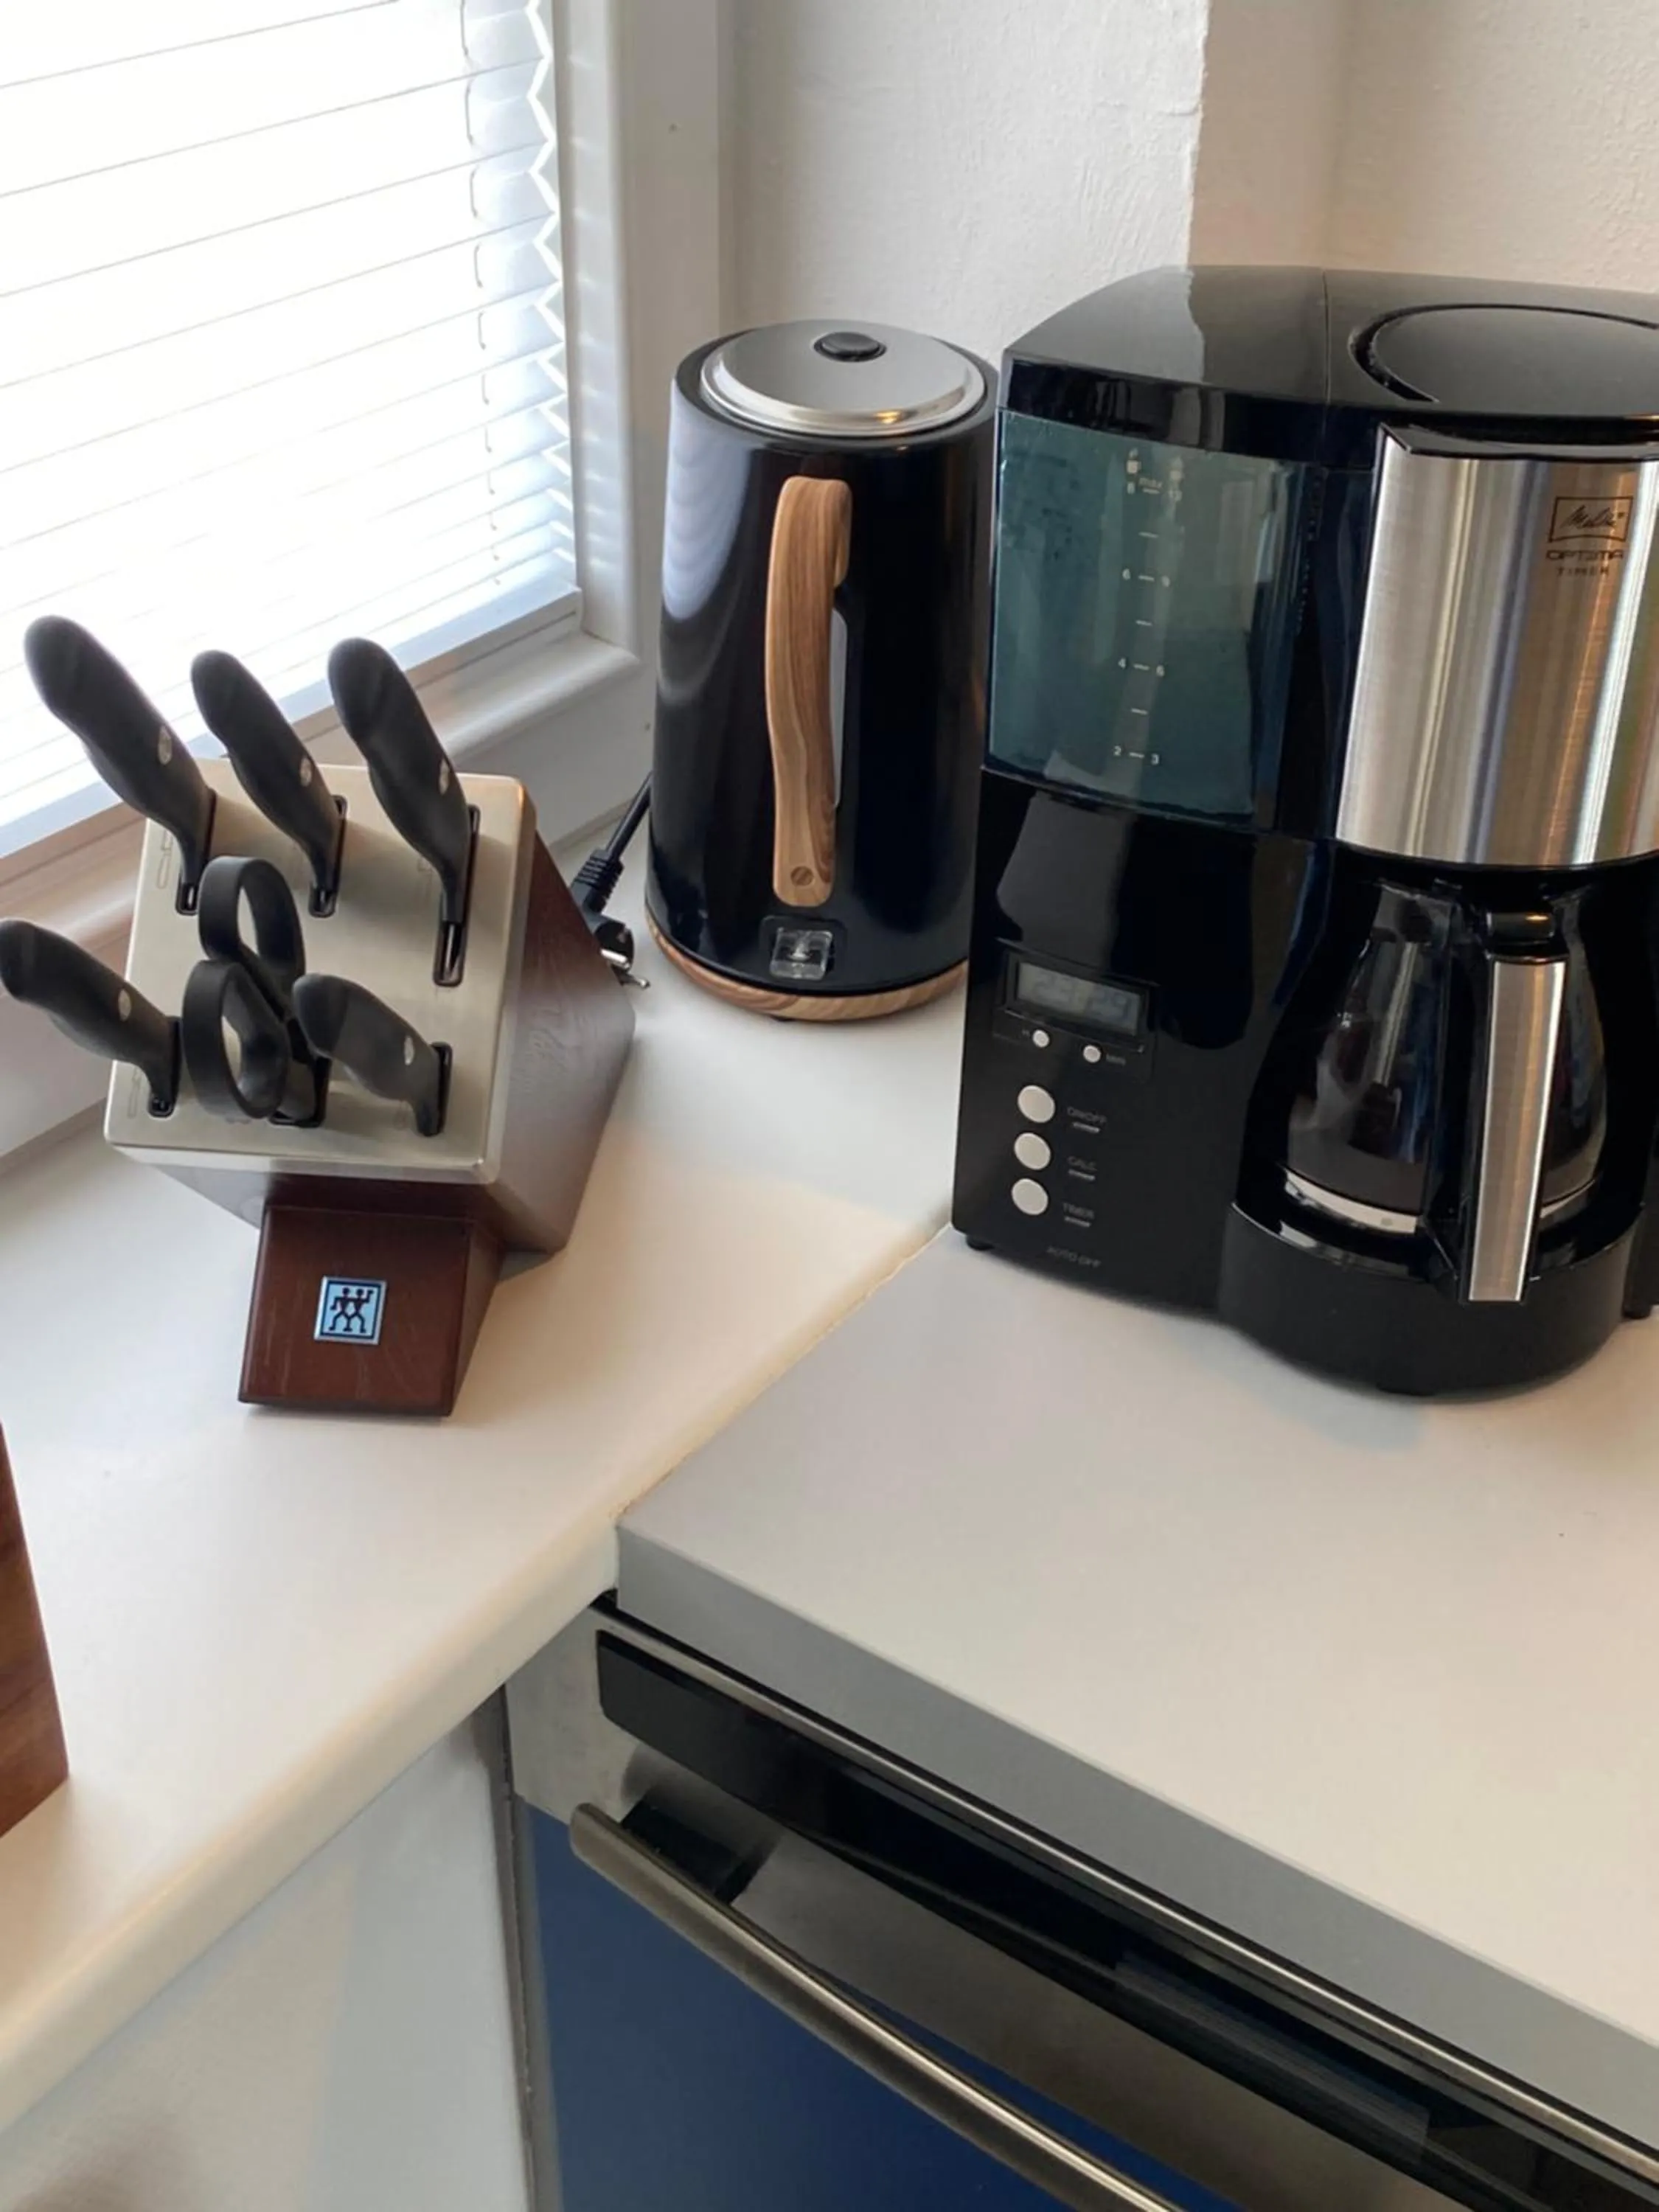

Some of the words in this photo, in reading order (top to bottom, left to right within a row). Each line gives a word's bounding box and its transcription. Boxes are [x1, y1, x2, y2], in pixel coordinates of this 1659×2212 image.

[1119, 658, 1127, 669] 4
[1113, 745, 1122, 757] 2
[1151, 754, 1159, 765] 3
